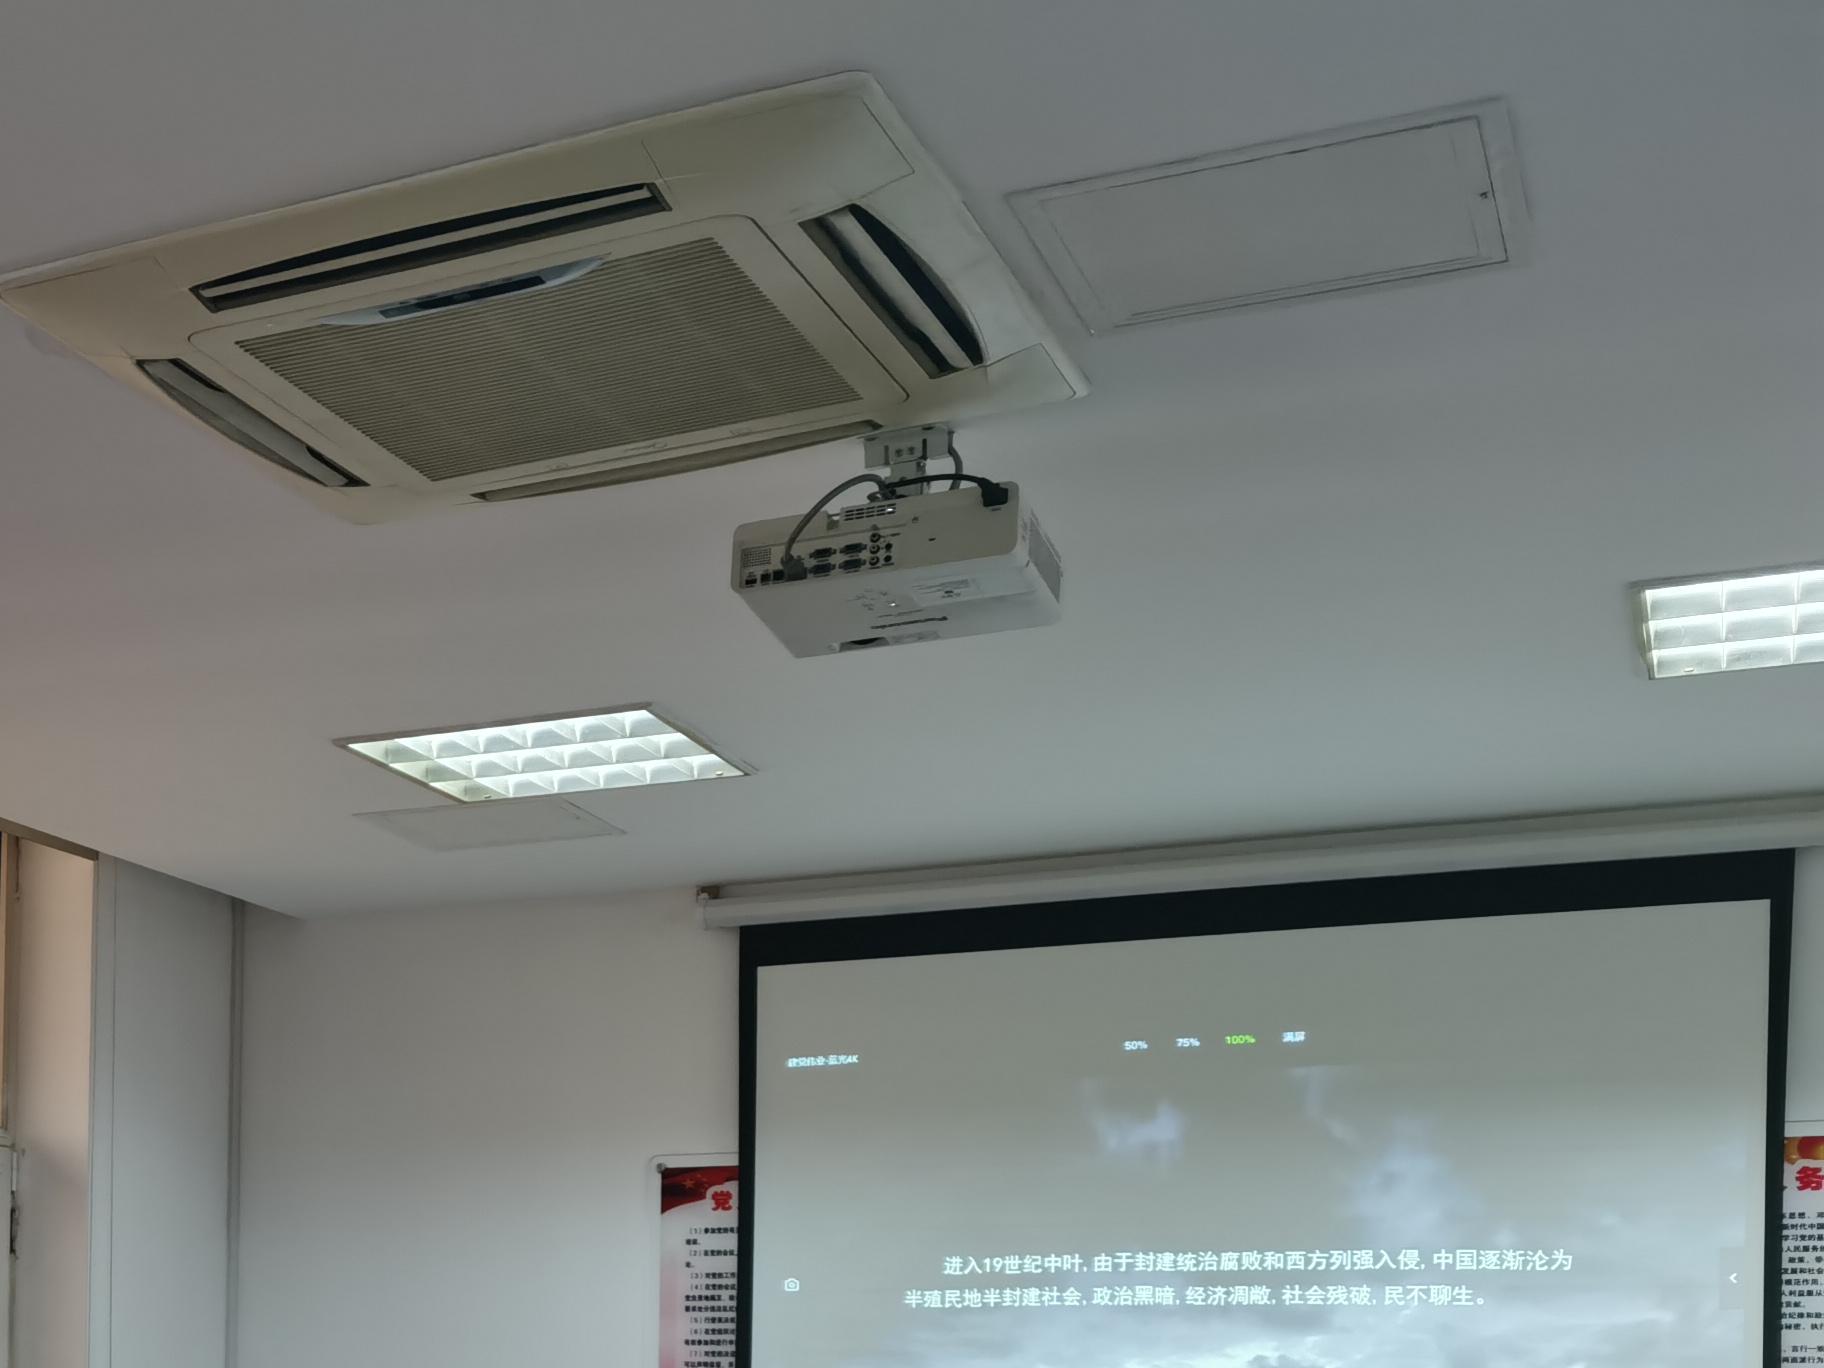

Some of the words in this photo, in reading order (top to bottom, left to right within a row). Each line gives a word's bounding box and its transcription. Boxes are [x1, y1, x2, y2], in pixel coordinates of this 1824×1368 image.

[1124, 1040, 1148, 1050] 50%
[1175, 1037, 1200, 1047] 75%
[1225, 1035, 1256, 1045] 100%
[1795, 1166, 1824, 1192] 务
